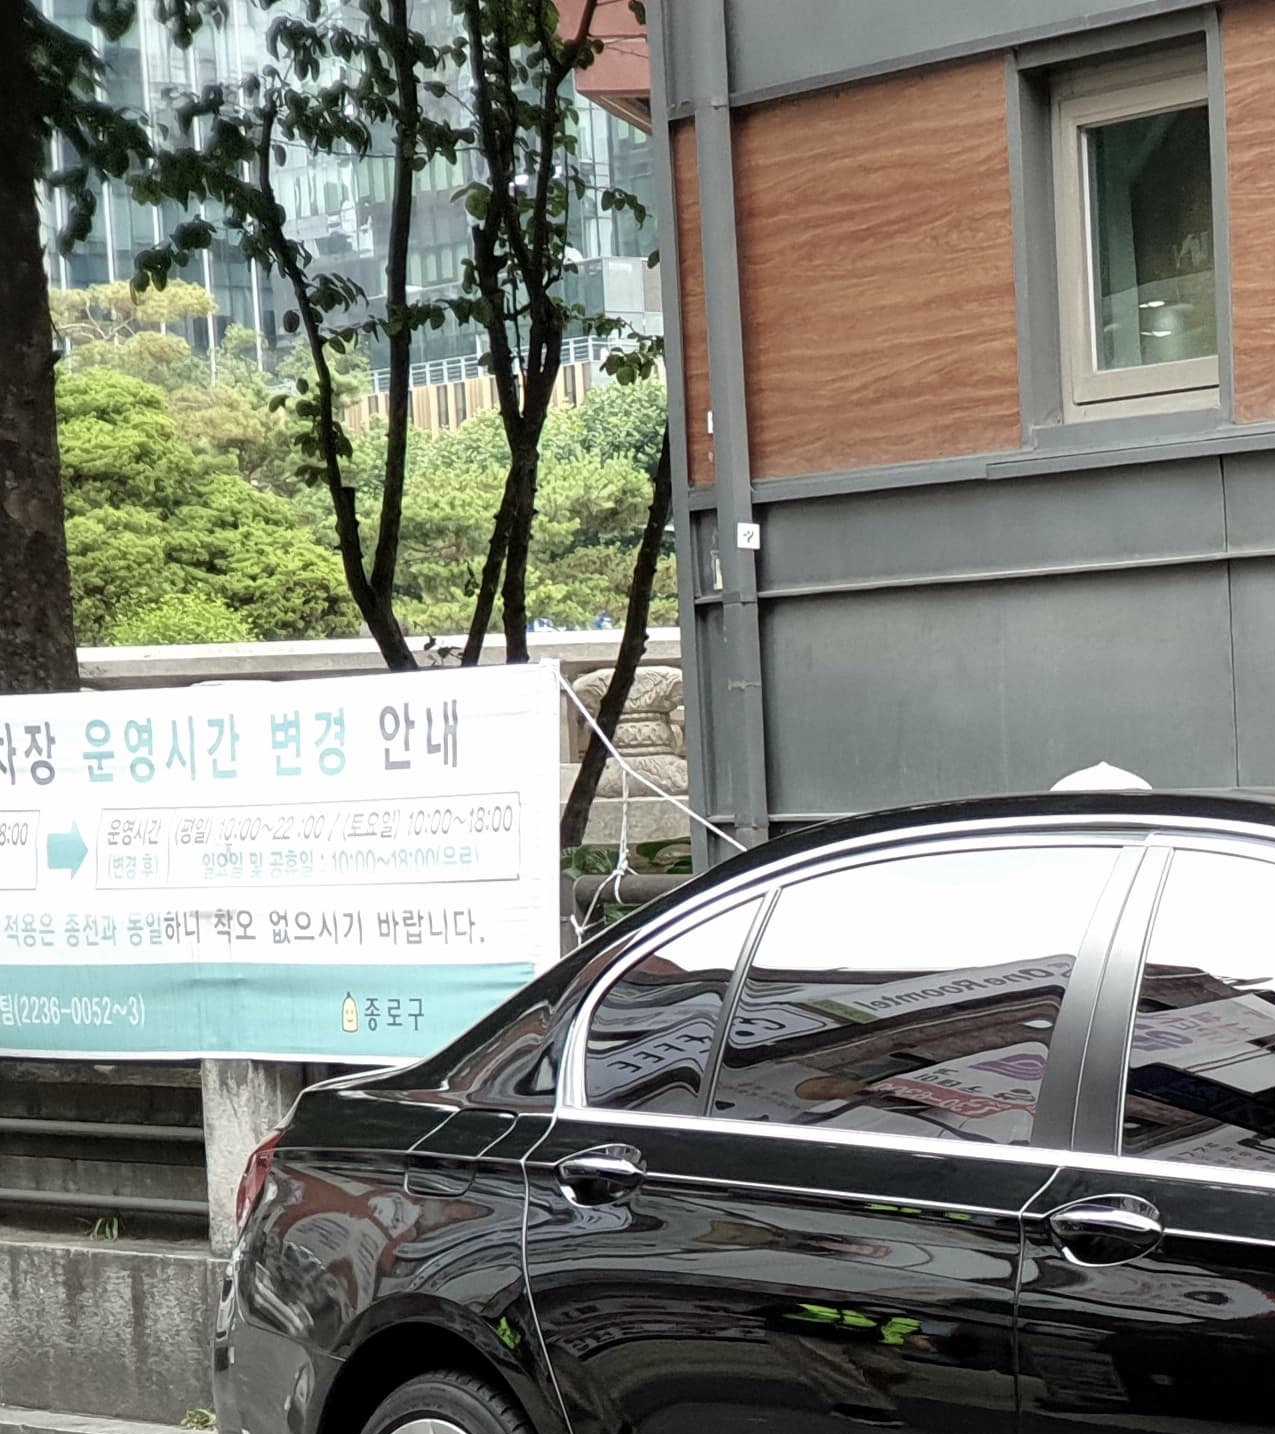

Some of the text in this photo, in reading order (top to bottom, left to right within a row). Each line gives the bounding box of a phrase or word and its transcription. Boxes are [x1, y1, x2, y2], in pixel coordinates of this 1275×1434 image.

[83, 715, 240, 783] 운영시간
[270, 707, 347, 776] 변경
[379, 699, 458, 771] 안내
[107, 818, 162, 846] 운영시간
[408, 804, 513, 836] 10:00~18:00
[4, 908, 485, 949] 적용은 종전과 동일하니 착오 없으시기 바랍니다.
[364, 997, 424, 1031] 종로구
